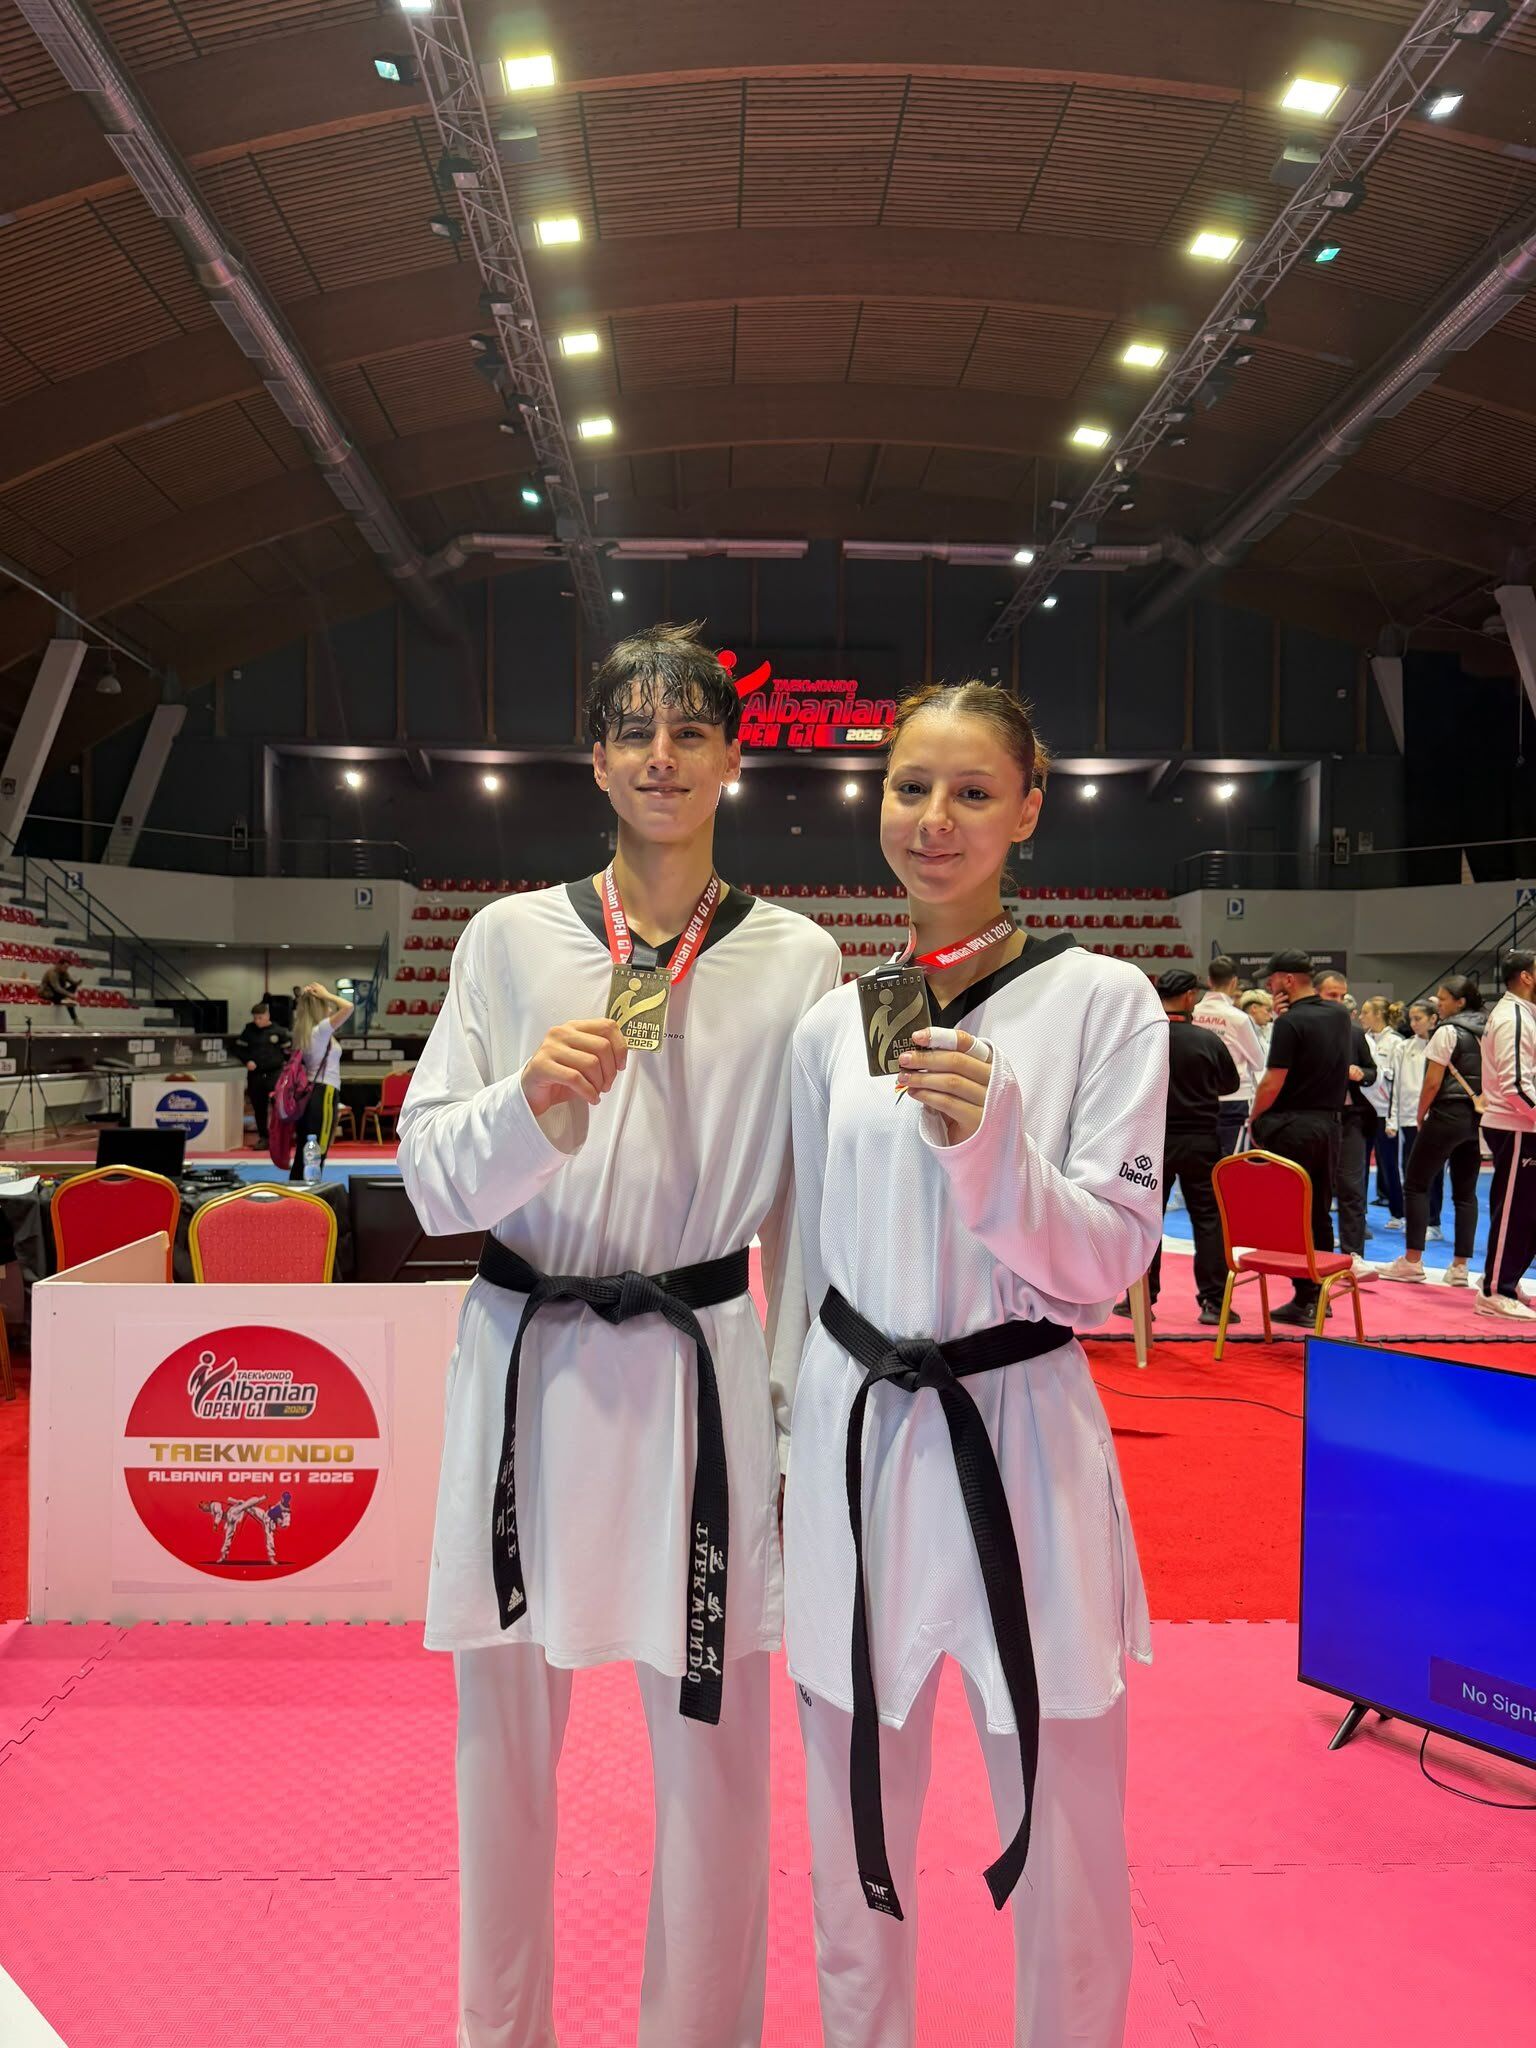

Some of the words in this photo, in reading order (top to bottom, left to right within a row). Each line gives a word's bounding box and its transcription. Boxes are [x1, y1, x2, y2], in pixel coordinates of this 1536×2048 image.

[772, 679, 858, 693] TAEKWONDO
[741, 692, 897, 724] Albanian
[738, 724, 781, 746] PEN
[788, 724, 815, 746] G1
[845, 728, 883, 742] 2026
[605, 862, 619, 910] lbanian
[357, 888, 371, 905] D
[684, 915, 704, 943] OPEN
[704, 877, 719, 905] 2026
[1229, 899, 1242, 915] D
[611, 911, 628, 937] OPEN
[991, 920, 1012, 940] 2026
[860, 975, 922, 992] TAEKWONDO
[626, 1028, 648, 1038] OPEN
[628, 1020, 660, 1031] ALBANIA
[628, 1038, 653, 1048] 2026
[1119, 1161, 1158, 1190] Daedo
[237, 1371, 292, 1380] TAEKWONDO
[216, 1381, 317, 1402] Albanian
[202, 1402, 241, 1417] OPEN
[246, 1402, 265, 1417] G1
[283, 1405, 308, 1415] 2026
[149, 1443, 355, 1463] TAEKWONDO
[148, 1471, 223, 1483] ALBANIA
[228, 1471, 274, 1483] OPEN
[278, 1472, 301, 1483] G1
[308, 1472, 355, 1484] 2026
[1462, 1681, 1488, 1705] No
